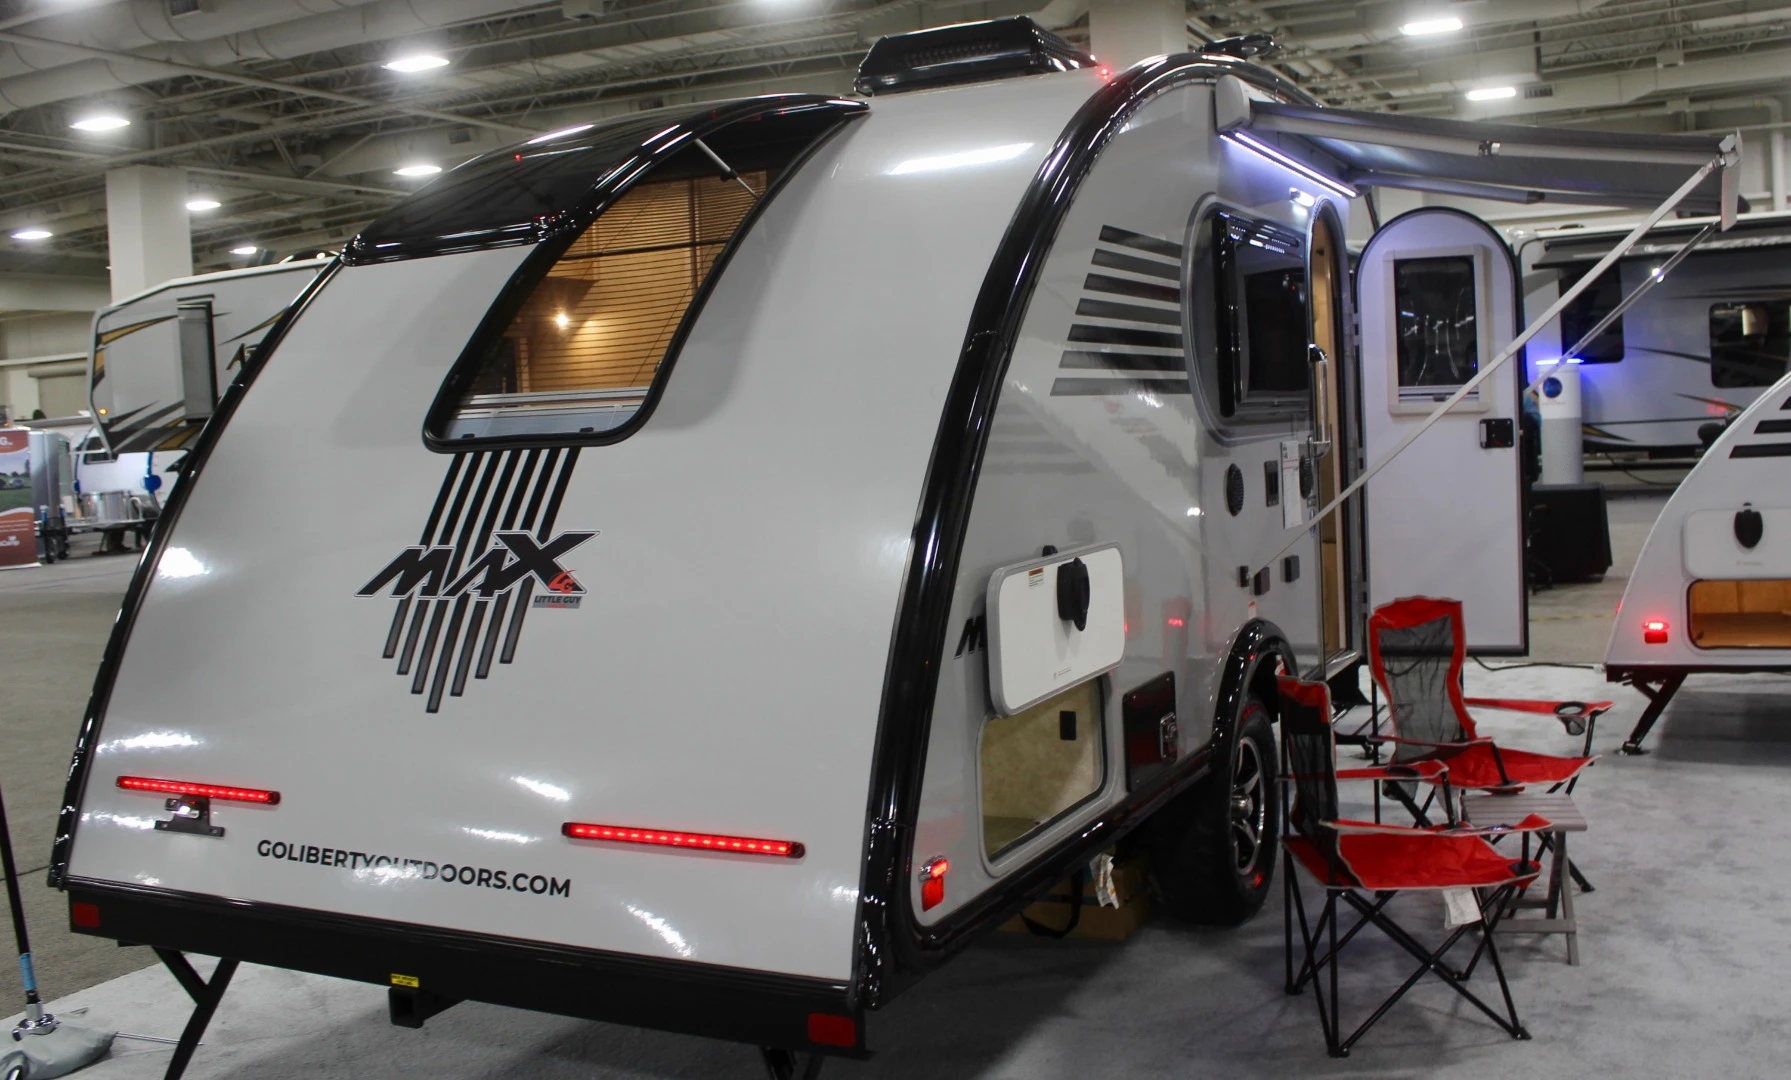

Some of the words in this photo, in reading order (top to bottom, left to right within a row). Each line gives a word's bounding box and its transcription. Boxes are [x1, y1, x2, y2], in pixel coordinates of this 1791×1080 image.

[354, 530, 601, 599] MAX
[534, 595, 562, 603] LITTLE
[563, 595, 582, 604] GUY
